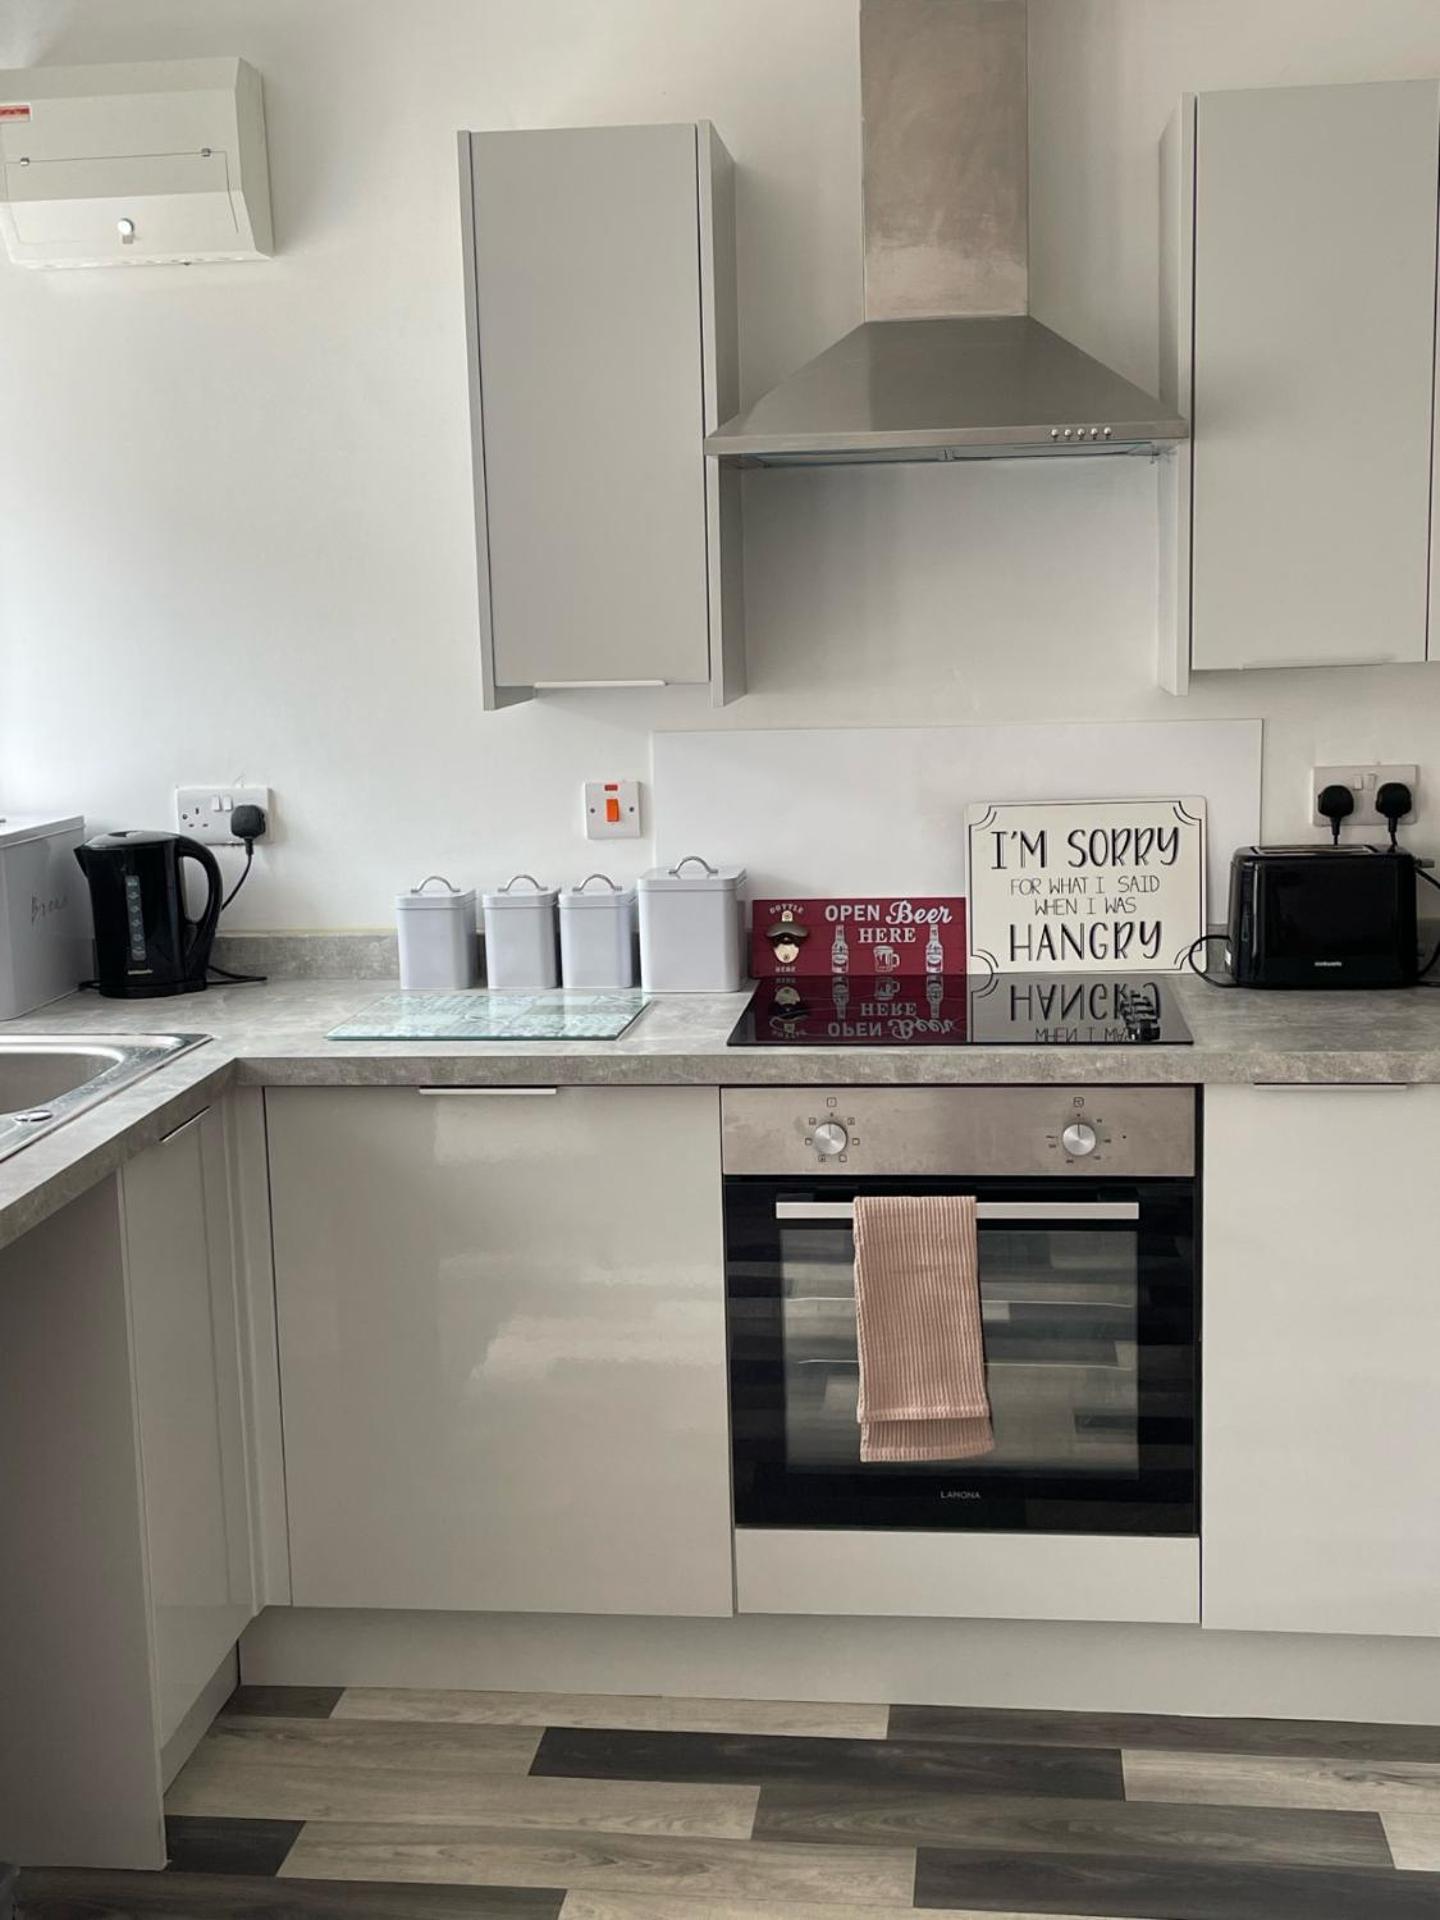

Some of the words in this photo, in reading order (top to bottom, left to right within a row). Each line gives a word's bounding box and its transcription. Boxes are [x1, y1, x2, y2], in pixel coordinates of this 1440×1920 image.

[990, 829, 1047, 870] I'M
[1067, 826, 1180, 868] SORRY
[1010, 877, 1042, 896] FOR
[1048, 876, 1088, 895] WHAT
[1095, 876, 1104, 895] I
[1117, 874, 1161, 894] SAID
[824, 904, 881, 922] OPEN
[885, 899, 953, 925] Beer
[1034, 897, 1078, 916] WHEN
[1087, 897, 1097, 916] I
[1104, 896, 1138, 915] WAS
[857, 927, 917, 944] HERE
[1010, 920, 1162, 962] HANGRY
